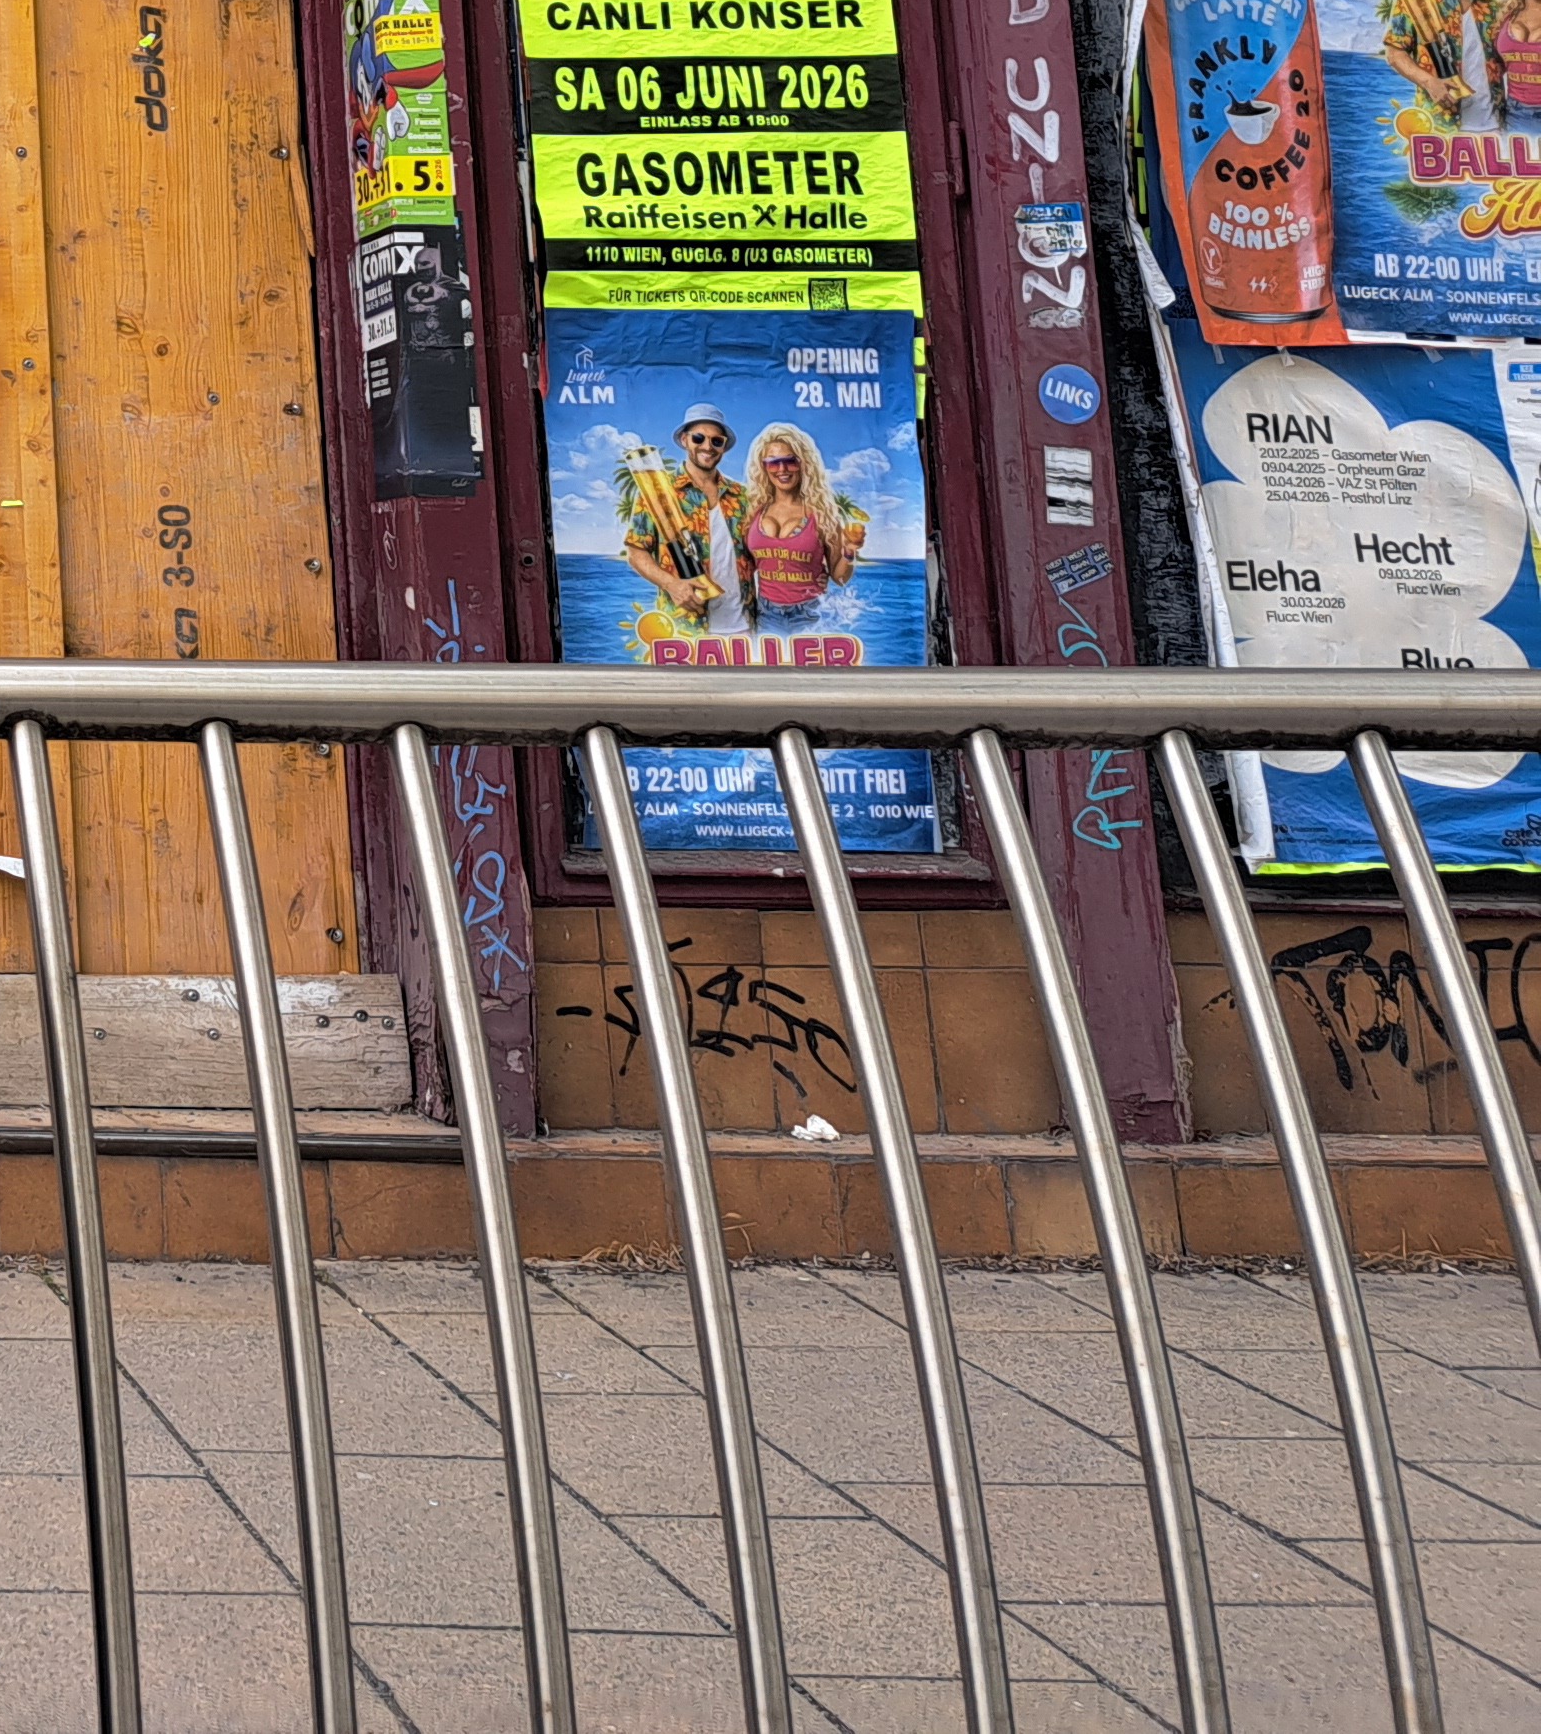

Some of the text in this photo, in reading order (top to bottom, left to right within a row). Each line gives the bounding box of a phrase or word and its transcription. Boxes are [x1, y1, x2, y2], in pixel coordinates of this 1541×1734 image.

[548, 0, 862, 30] CANLI KONSER
[1202, 1, 1277, 26] LATTE
[555, 62, 869, 111] SA 06 JUNI 2026
[1187, 34, 1280, 144] FRANKLY
[639, 114, 790, 128] EINLASS AB 18:00
[576, 149, 864, 197] GASOMETER
[1214, 128, 1311, 192] COFFEE
[583, 203, 867, 229] Raiffeisen Halle
[1224, 201, 1268, 225] 100
[1209, 214, 1311, 251] BEANLESS
[586, 247, 872, 266] 1110 WIEN, GUGLG. 8 (U3 GASOMETER)
[1374, 254, 1505, 282] AB 22:00 UHR
[609, 287, 804, 304] FÜR TICKETS QR-CODE SCANNEN
[788, 347, 880, 376] OPENING
[558, 384, 615, 405] ALM
[795, 382, 882, 410] 28. MAI
[1045, 377, 1094, 409] LINKS
[1247, 412, 1334, 445] RIAN
[1331, 449, 1432, 463] Gasometer Wien
[1337, 464, 1426, 479] Orpheum Graz
[1354, 532, 1456, 567] Hecht
[1226, 560, 1321, 593] Eleha
[645, 768, 907, 796] 22:00 UHR FREI
